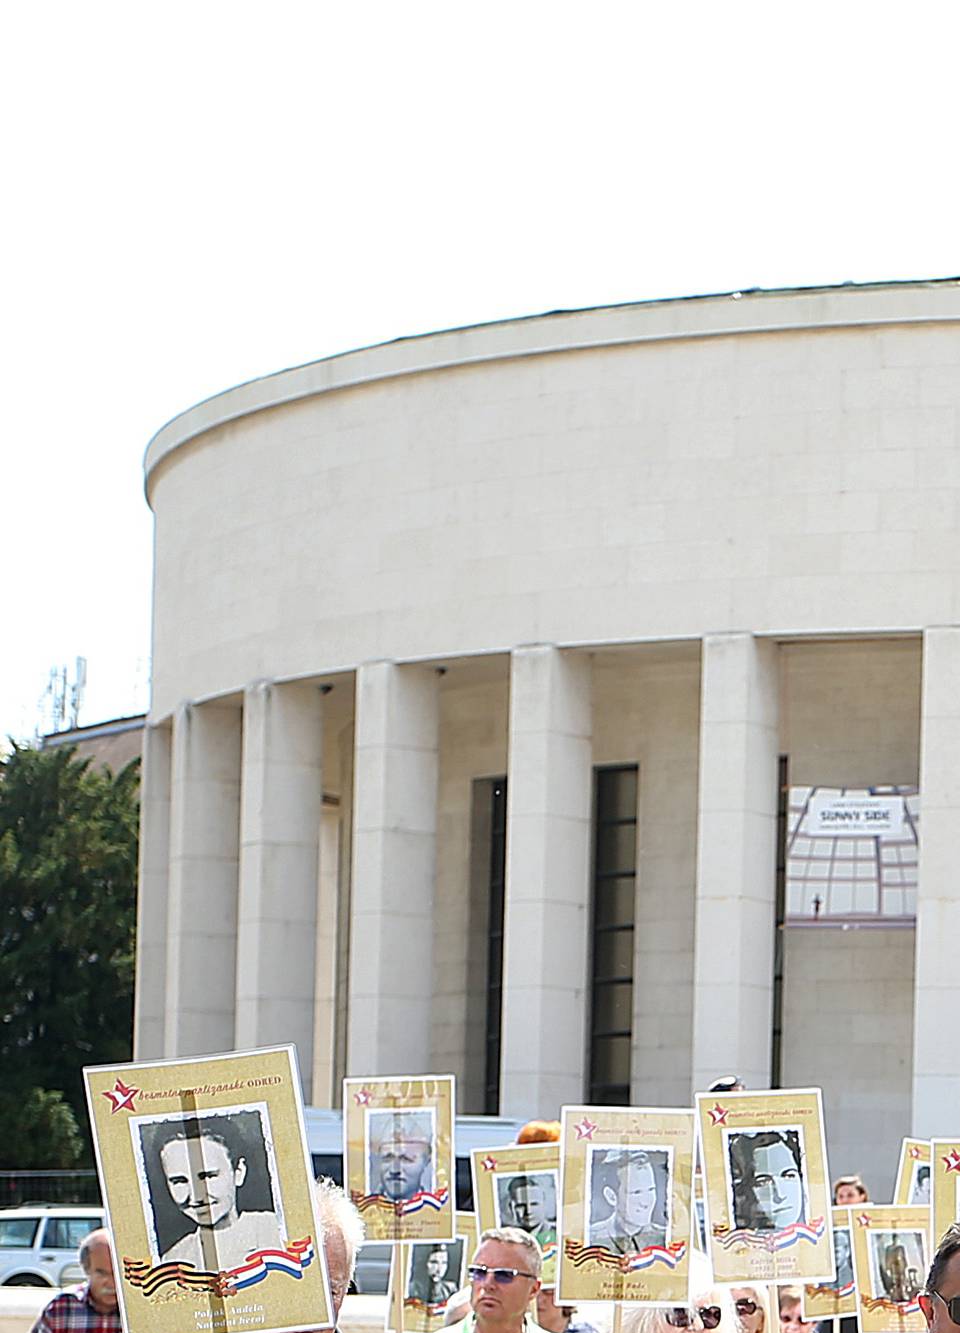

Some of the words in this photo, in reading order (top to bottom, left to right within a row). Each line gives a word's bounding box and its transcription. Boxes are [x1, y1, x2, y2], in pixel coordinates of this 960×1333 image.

[138, 1088, 182, 1101] besmrtni
[185, 1080, 244, 1098] partizanski
[247, 1076, 282, 1088] ODRED
